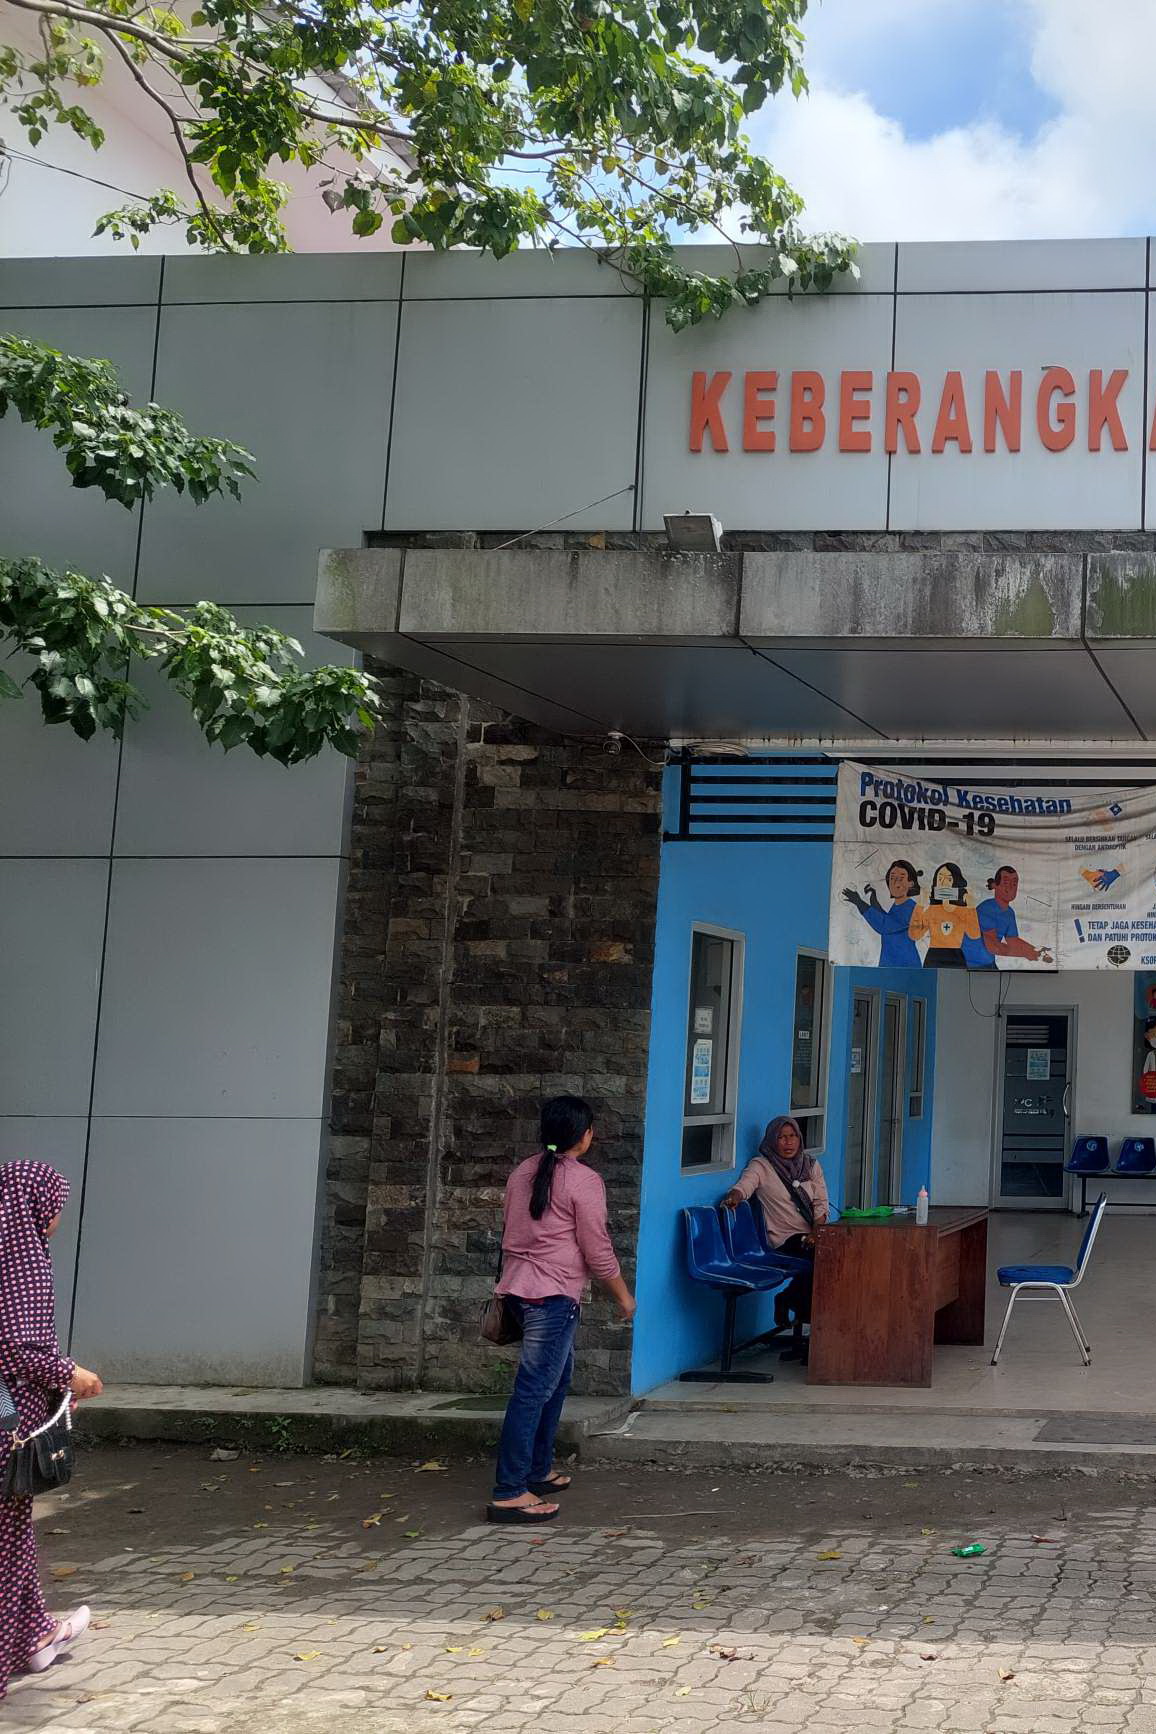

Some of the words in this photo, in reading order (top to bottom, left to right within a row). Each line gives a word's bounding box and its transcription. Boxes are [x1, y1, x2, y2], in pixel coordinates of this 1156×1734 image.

[860, 771, 949, 807] Protokol
[956, 788, 1072, 815] Kesehatan
[859, 799, 996, 837] COVID-19
[1088, 921, 1109, 930] TETAP
[1110, 921, 1129, 930] JAGA
[1088, 933, 1102, 942] DAN
[1104, 933, 1128, 941] PATUHI
